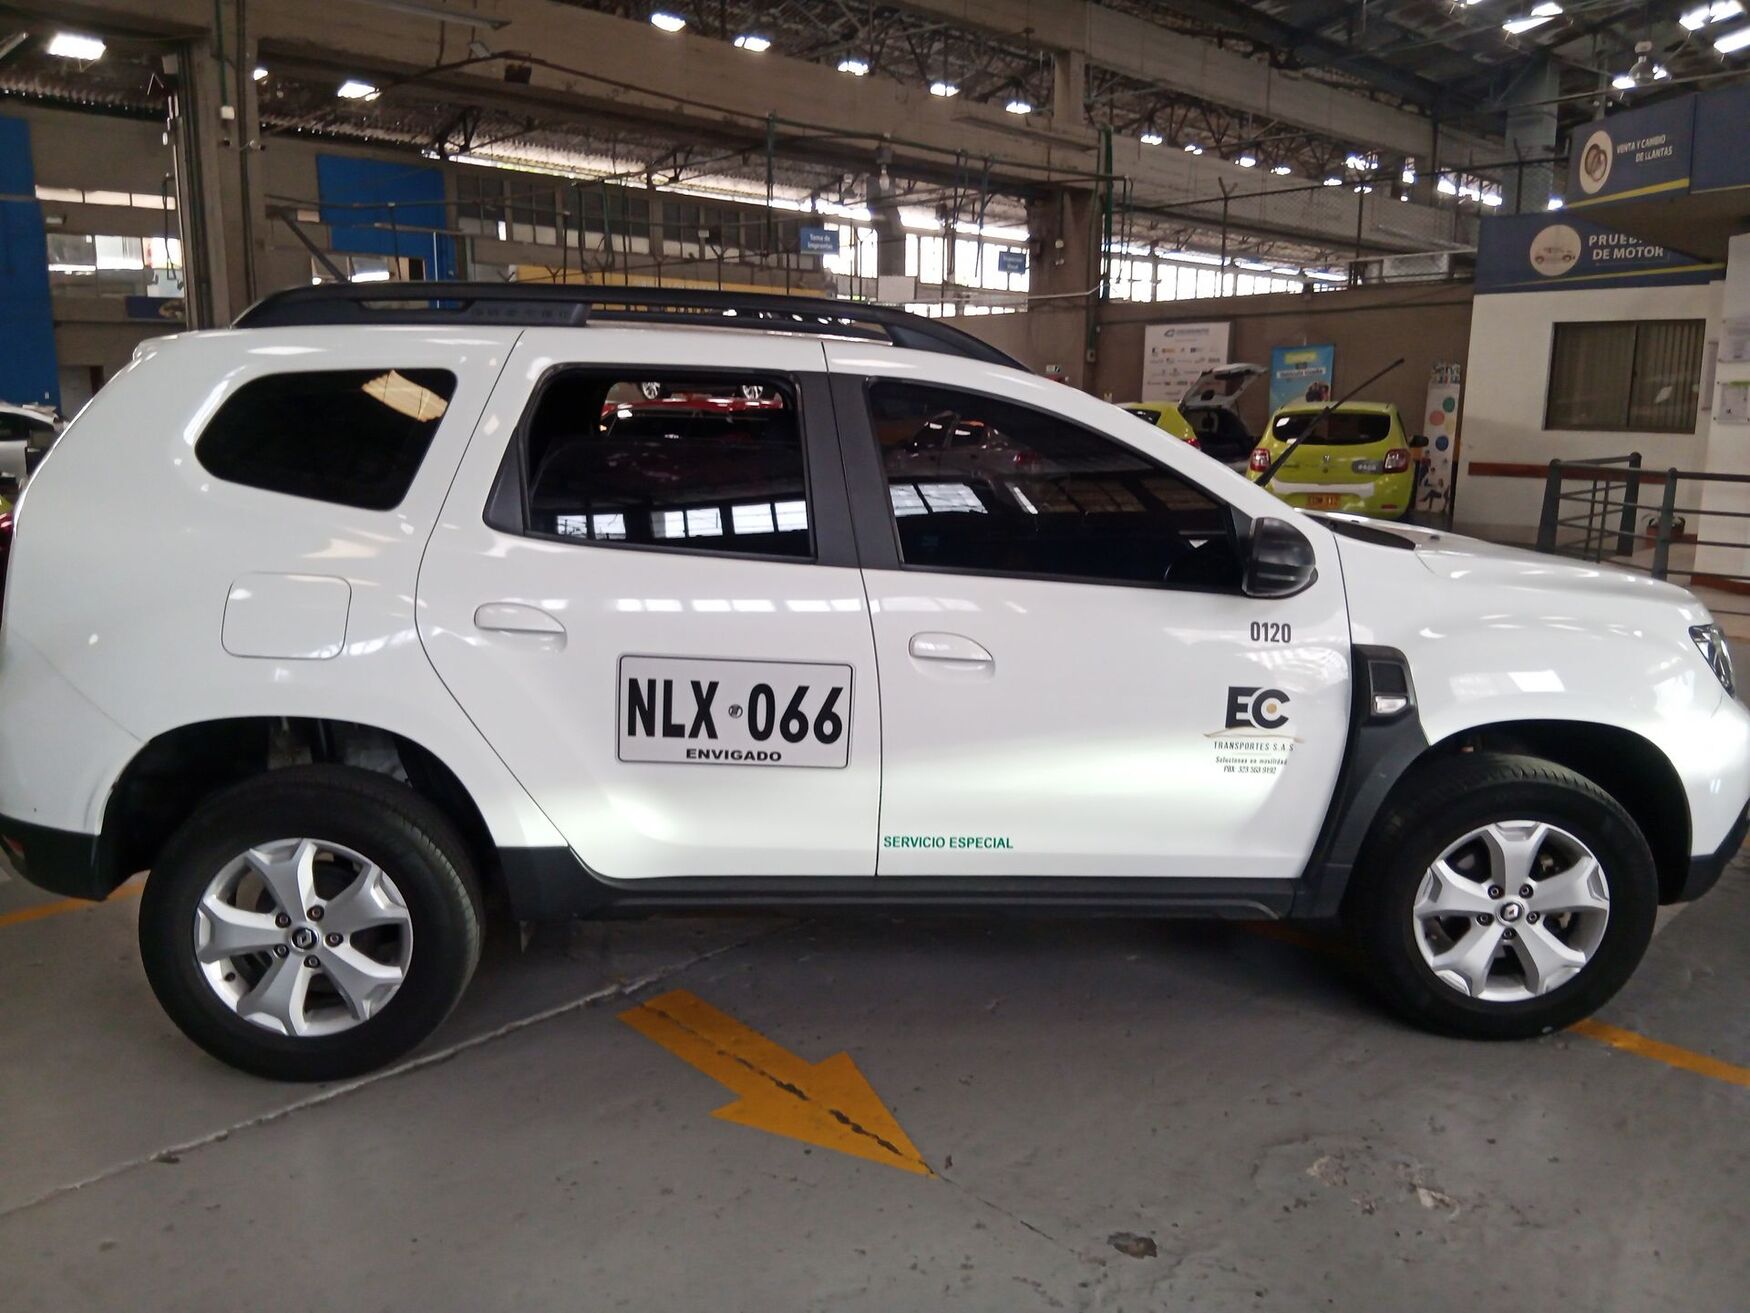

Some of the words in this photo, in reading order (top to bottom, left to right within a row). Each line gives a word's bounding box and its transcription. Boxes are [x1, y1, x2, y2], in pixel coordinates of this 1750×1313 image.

[1616, 141, 1635, 154] VENTA
[1641, 134, 1666, 148] CAMBIO
[1635, 152, 1644, 162] DE
[1644, 146, 1673, 160] LLANTAS
[1592, 248, 1610, 260] DE
[1613, 246, 1664, 259] MOTOR
[1250, 621, 1292, 643] 0120
[627, 677, 720, 740] NLX
[747, 683, 844, 745] 066
[1225, 686, 1290, 729] EC
[1214, 741, 1270, 751] TRANSPORTES
[686, 748, 782, 762] ENVIGADO
[883, 836, 946, 848] SERVICIO
[949, 836, 1014, 849] ESPECIAL
